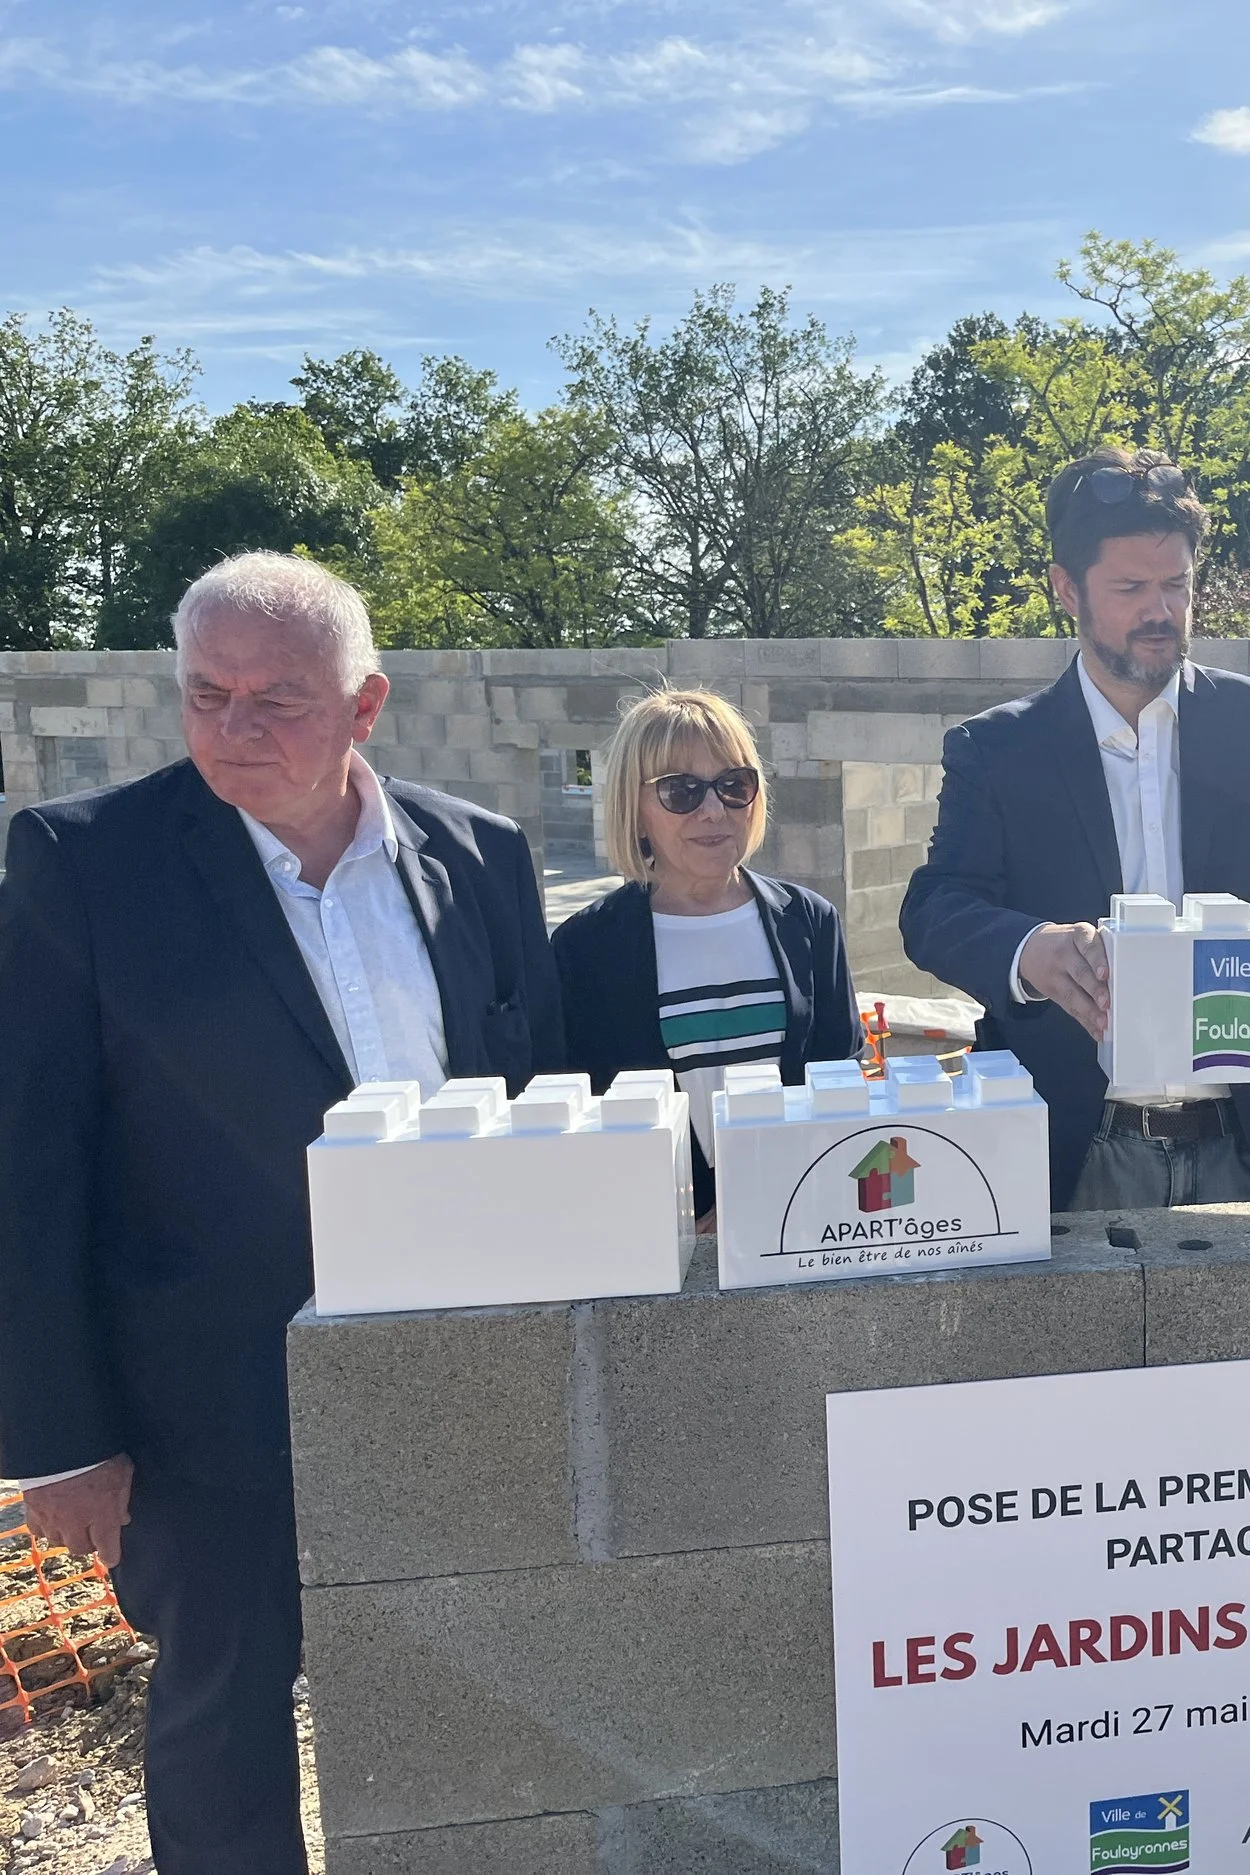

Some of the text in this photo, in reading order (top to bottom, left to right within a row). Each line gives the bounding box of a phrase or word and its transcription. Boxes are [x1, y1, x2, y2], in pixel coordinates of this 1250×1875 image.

[820, 1217, 962, 1244] APART'âges
[798, 1240, 983, 1268] Le bien être de nos aînés
[908, 1491, 1019, 1531] POSE
[1032, 1484, 1083, 1520] DE
[1095, 1479, 1147, 1513] LA
[872, 1632, 977, 1688] LES
[992, 1602, 1248, 1676] JARDINS
[1021, 1711, 1119, 1749] Mardi
[1132, 1705, 1174, 1735] 27
[1186, 1695, 1248, 1729] mai
[1101, 1807, 1146, 1823] Ville de
[1092, 1839, 1188, 1862] Foulayronnes
